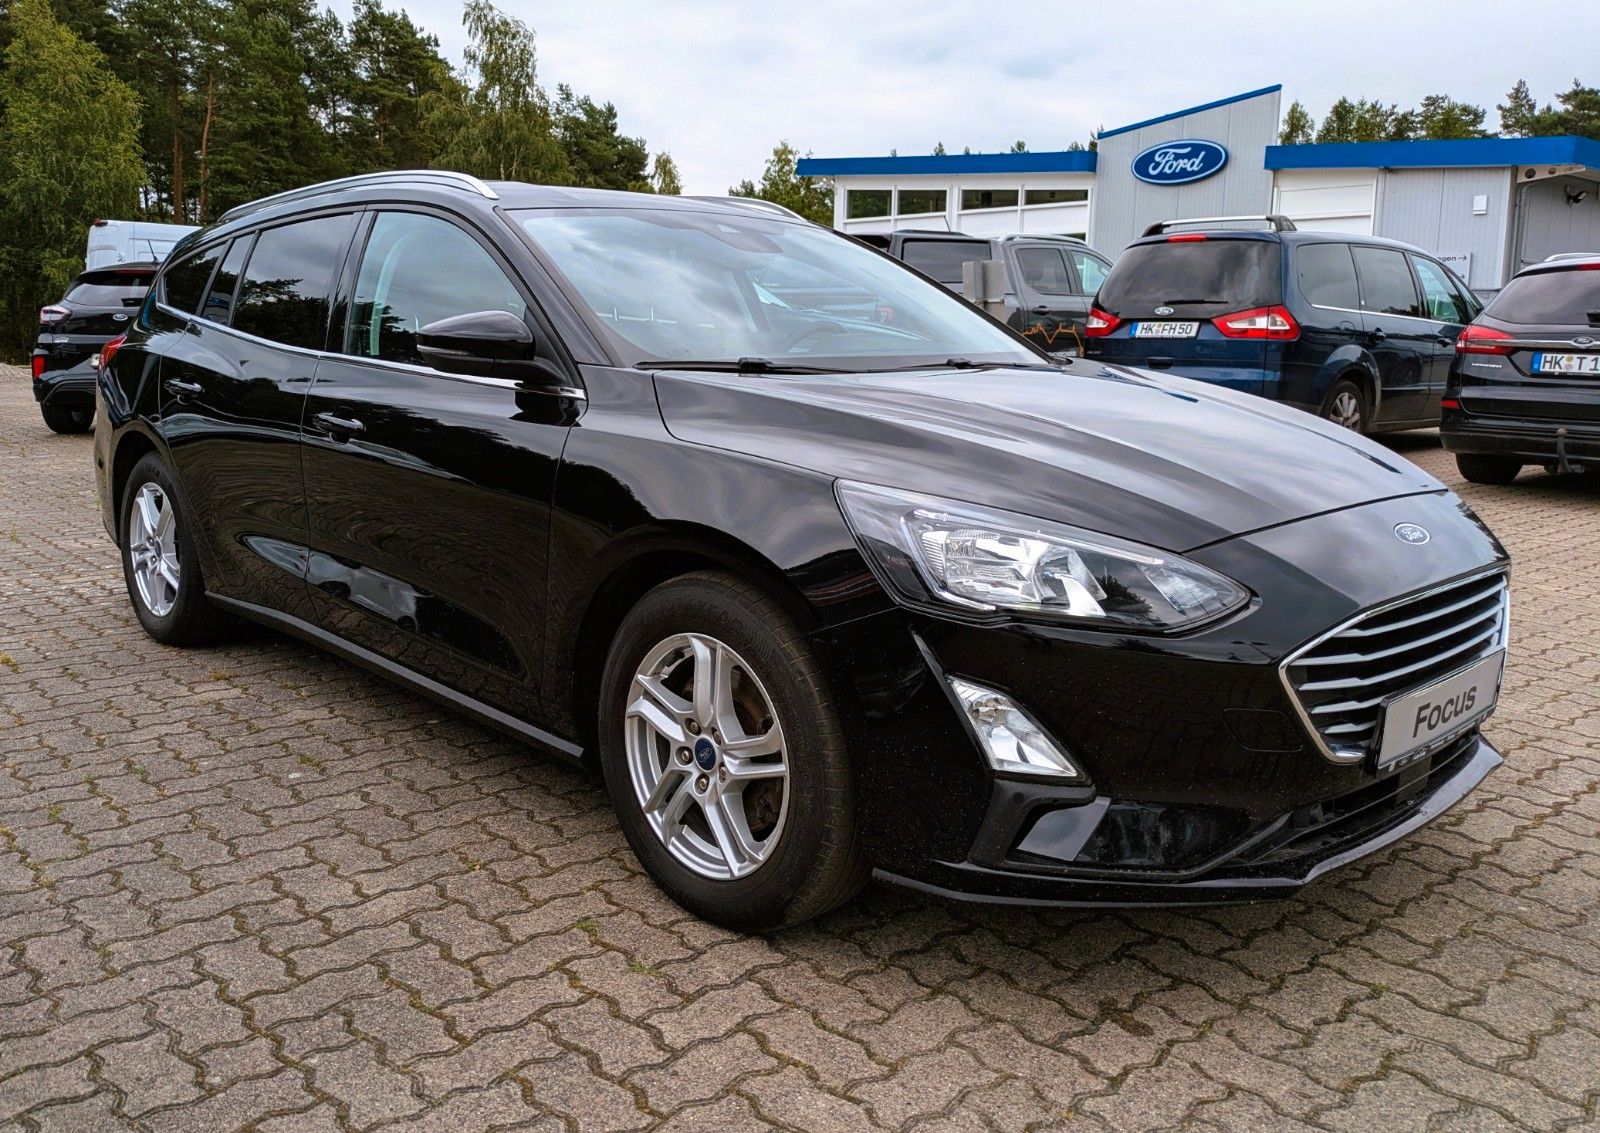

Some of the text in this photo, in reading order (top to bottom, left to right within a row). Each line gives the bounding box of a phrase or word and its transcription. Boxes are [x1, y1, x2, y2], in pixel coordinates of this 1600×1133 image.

[1148, 146, 1206, 175] Ford
[1140, 323, 1156, 334] HK
[1541, 355, 1564, 370] HK
[1576, 356, 1587, 371] T
